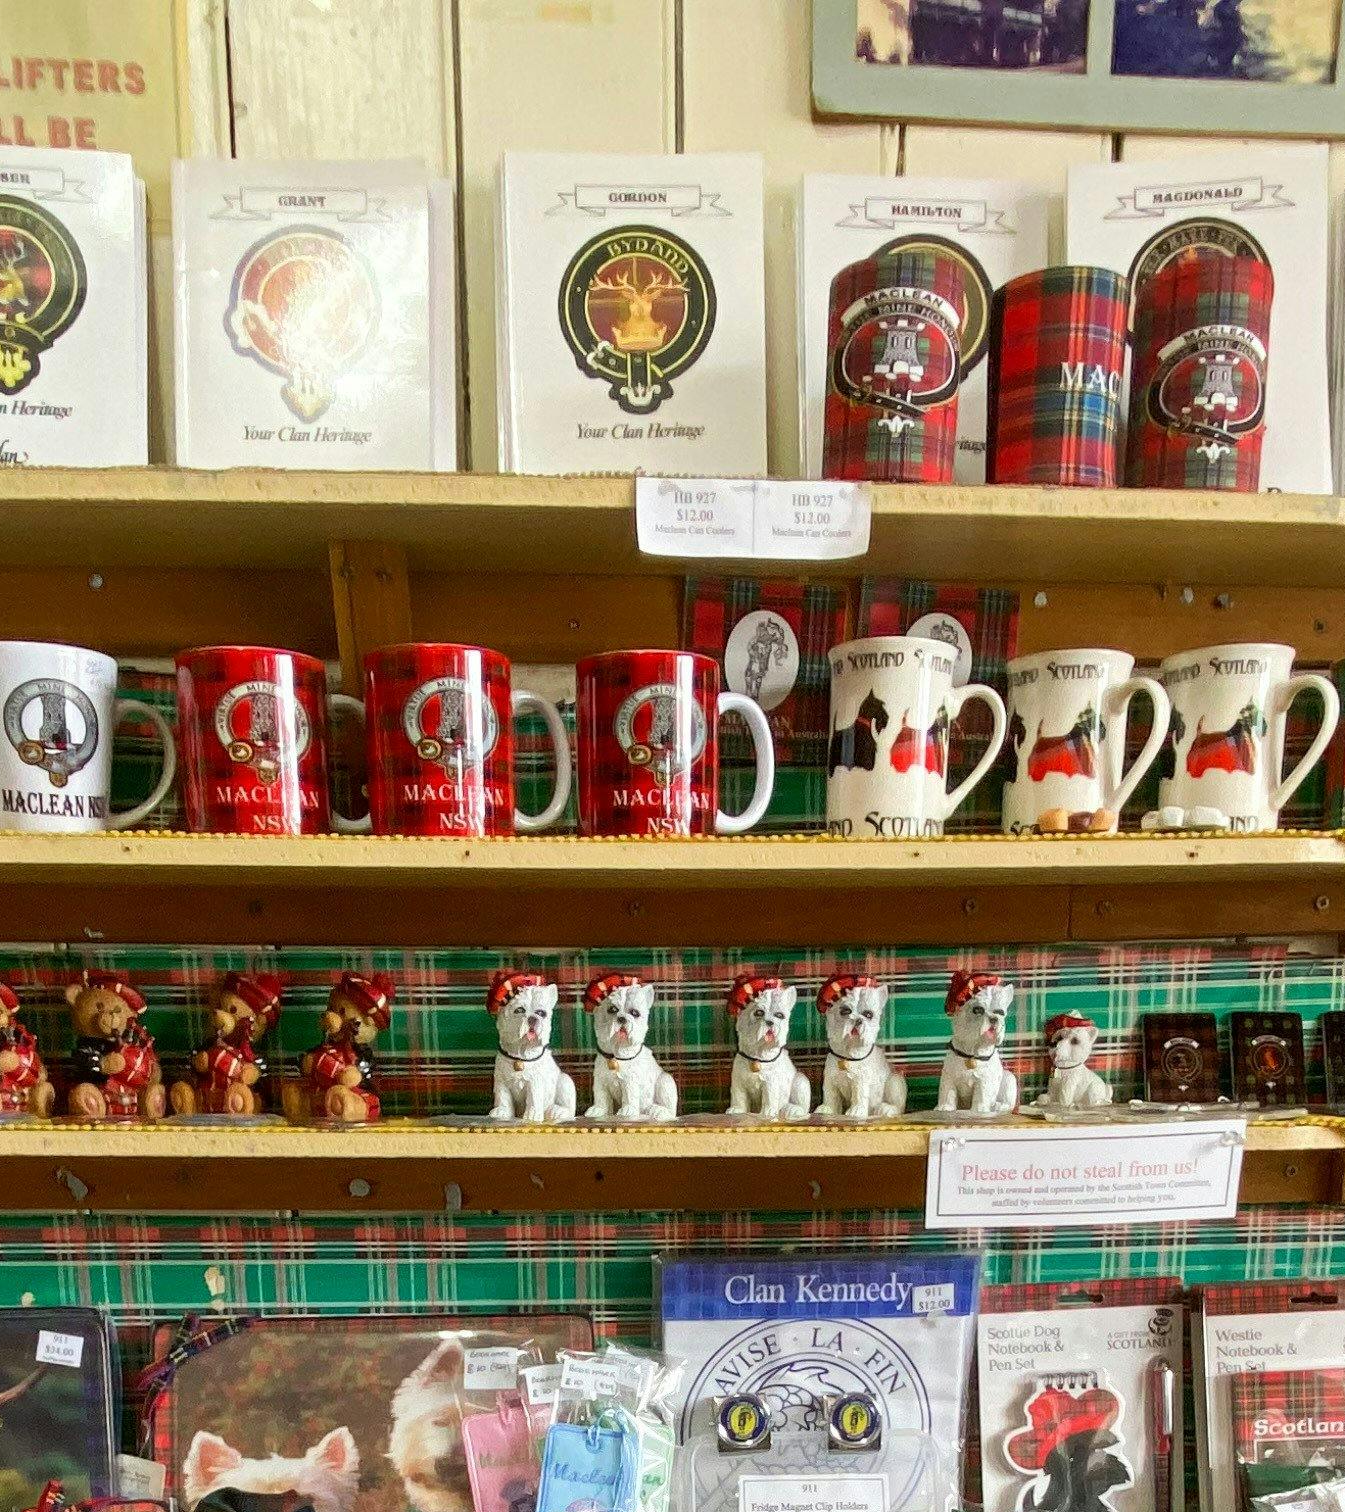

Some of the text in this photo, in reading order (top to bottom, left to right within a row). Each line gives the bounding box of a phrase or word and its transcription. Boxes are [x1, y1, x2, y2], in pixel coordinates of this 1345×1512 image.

[46, 117, 97, 150] BE
[277, 193, 327, 210] GRANT
[608, 191, 667, 204] GORDON
[1153, 186, 1244, 204] MACDONALD
[891, 203, 962, 219] HAMILTON
[607, 236, 692, 274] BYDAND
[864, 287, 944, 308] MACLEAN
[1183, 325, 1255, 343] MACLEAN
[10, 399, 74, 419] Heritage
[243, 424, 372, 446] Your Clan Heritage
[576, 423, 705, 441] Your Clan Heritage
[696, 491, 717, 503] 927
[812, 494, 833, 507] 927
[676, 509, 714, 522] $12.00
[793, 512, 831, 525] $12.00
[2, 788, 86, 818] MACLEAN
[960, 1158, 1199, 1181] Please do not steal from us!
[724, 1269, 914, 1310] Clan Kennedy
[923, 1286, 945, 1299] 911
[811, 1325, 846, 1351] LA
[987, 1325, 1061, 1342] Scottie Dog
[1215, 1327, 1263, 1341] Westie
[987, 1340, 1065, 1356] Notebook &
[1106, 1336, 1173, 1352] SCOTLAND
[1215, 1343, 1298, 1359] Notebook &
[713, 1334, 784, 1399] AVISE
[865, 1347, 910, 1395] FIN
[989, 1357, 1035, 1371] Pen Set
[1216, 1359, 1241, 1374] Pen
[802, 1482, 818, 1494] 911
[835, 1500, 869, 1512] Holders
